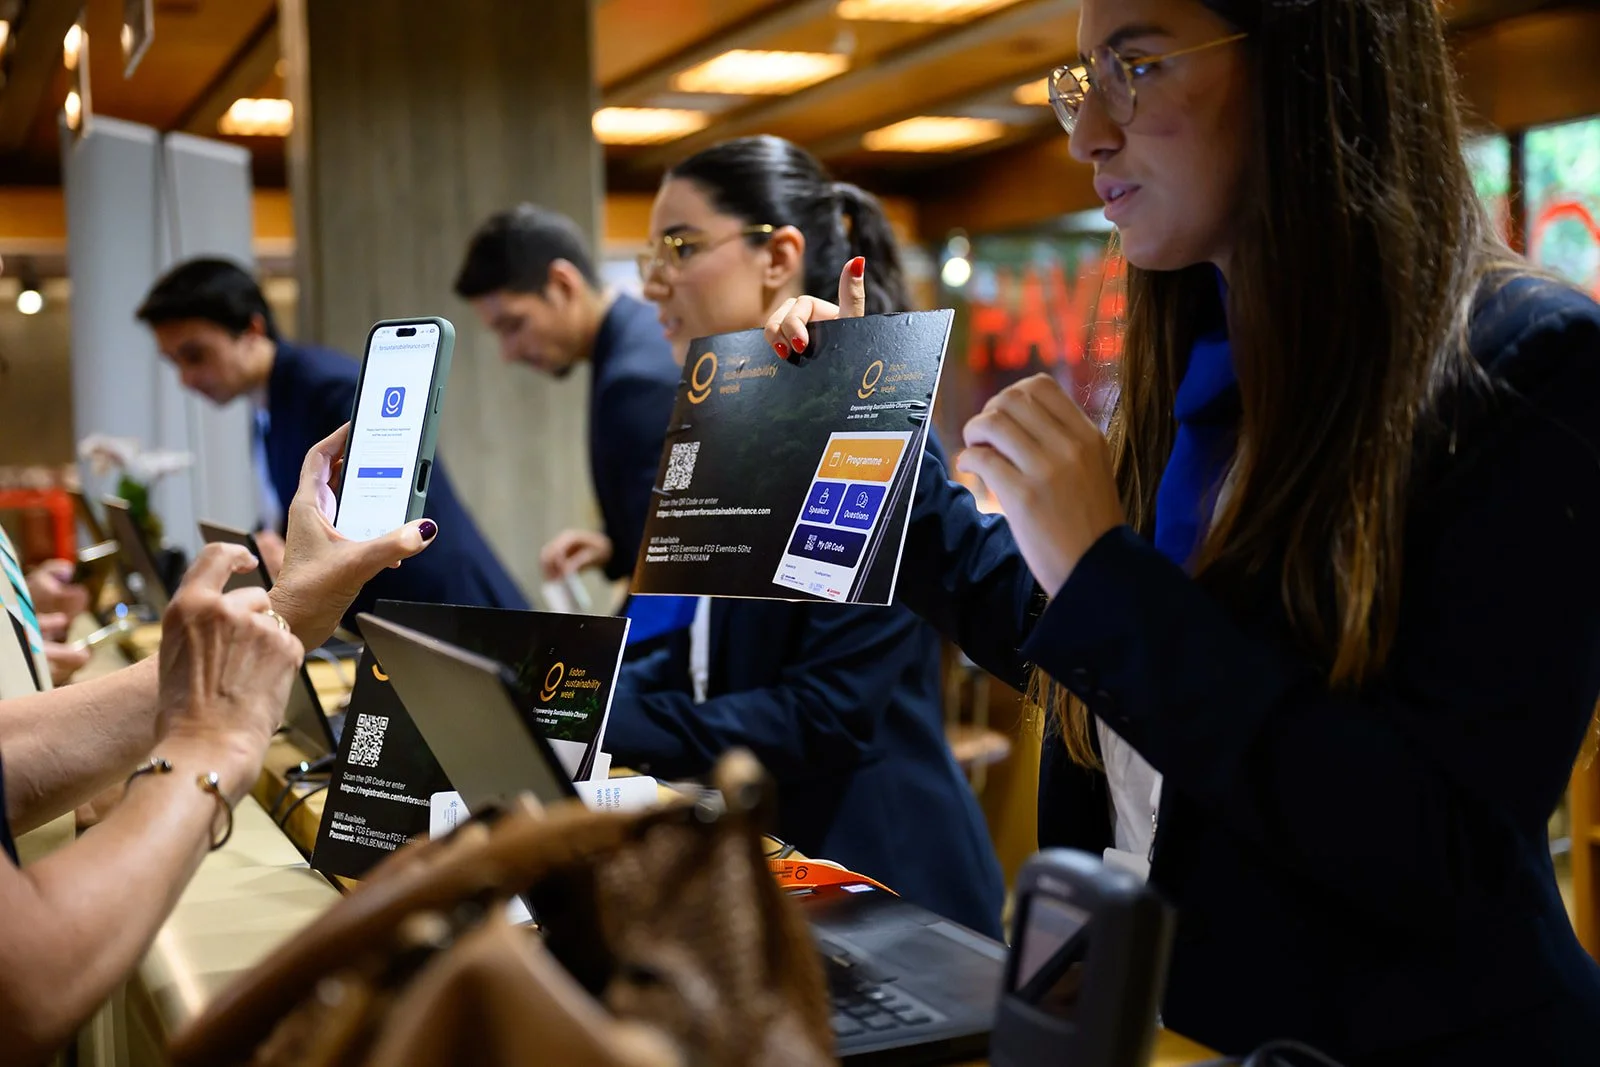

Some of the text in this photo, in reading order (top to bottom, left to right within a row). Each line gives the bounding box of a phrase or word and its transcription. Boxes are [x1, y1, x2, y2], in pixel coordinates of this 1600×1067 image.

[719, 382, 742, 394] week
[846, 454, 883, 467] Programme
[659, 499, 670, 507] Scan
[669, 499, 679, 507] the
[678, 498, 687, 507] QR
[686, 497, 699, 506] Code
[704, 497, 719, 505] enter
[808, 505, 830, 516] Speakers
[843, 509, 870, 521] Questions
[659, 536, 680, 544] Available
[647, 545, 669, 554] Network:
[669, 545, 680, 553] FCG
[679, 545, 700, 553] Eventos
[703, 544, 716, 553] FCG
[715, 545, 737, 553] Eventos
[737, 545, 752, 554] 5Ghz
[817, 540, 845, 553] My QR Code
[645, 554, 710, 563] Password: #GULBENKIAN#
[568, 667, 586, 676] lisbon
[564, 679, 601, 691] sustainability
[560, 690, 575, 699] week
[573, 711, 589, 720] Change
[342, 771, 356, 781] Scan
[355, 773, 365, 783] the
[364, 774, 373, 784] QR
[372, 776, 386, 787] Code
[391, 780, 407, 790] enter
[340, 782, 430, 807] https://registration.centerforsusta
[613, 787, 621, 808] lisbon
[333, 811, 366, 826] Wifi Available
[331, 820, 355, 833] Network:
[354, 825, 367, 836] FCG
[365, 827, 387, 840] Eventos
[390, 832, 402, 843] FCG
[329, 829, 398, 851] Password: #GULBENKIAN#
